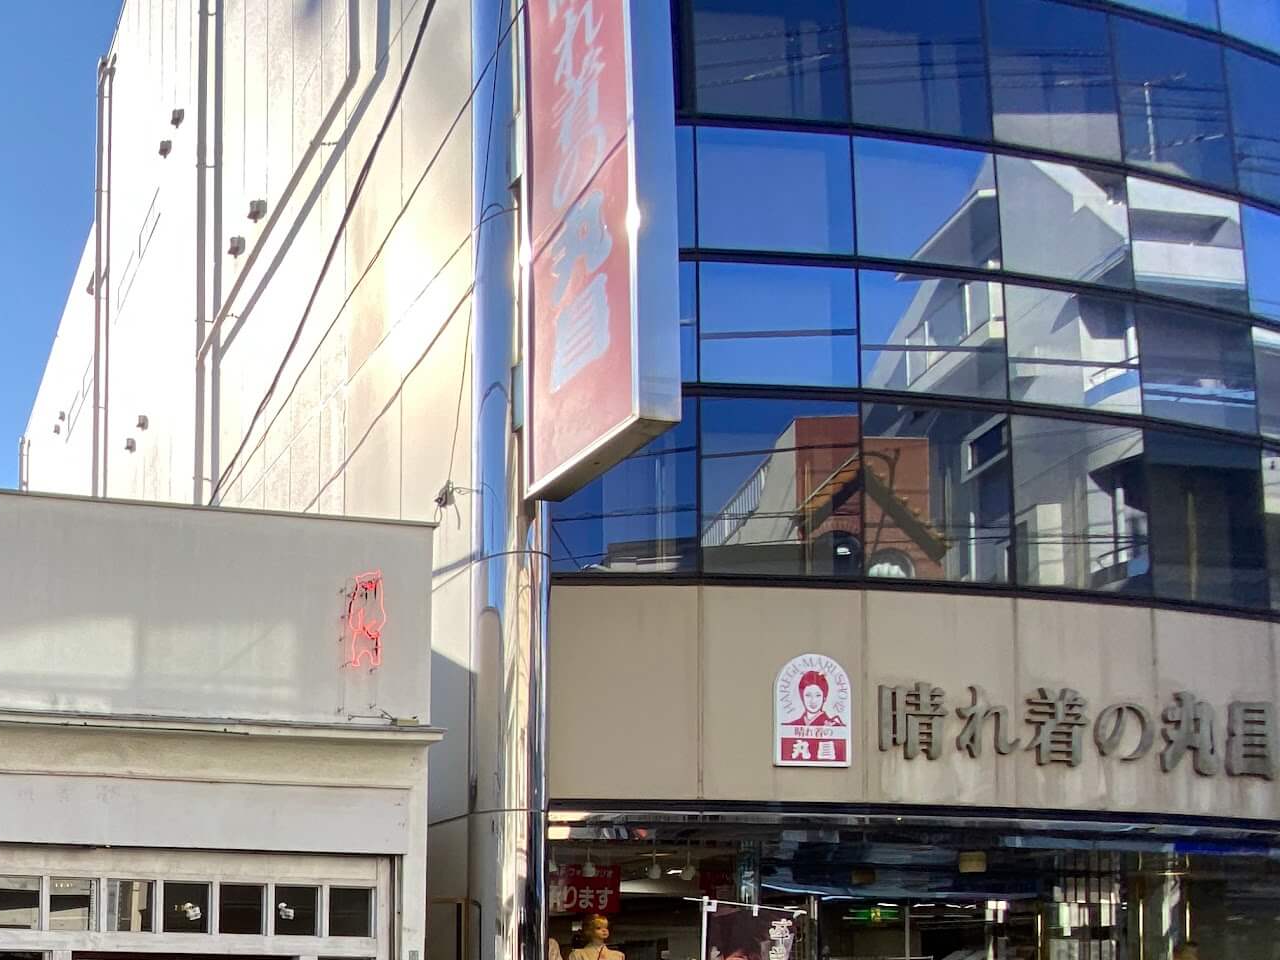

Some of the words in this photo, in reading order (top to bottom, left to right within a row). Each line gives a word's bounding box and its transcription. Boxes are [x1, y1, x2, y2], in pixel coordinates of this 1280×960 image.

[550, 0, 613, 394] れ着の丸昌
[792, 740, 836, 760] 丸昌
[877, 680, 1274, 781] 晴れ着の丸昌
